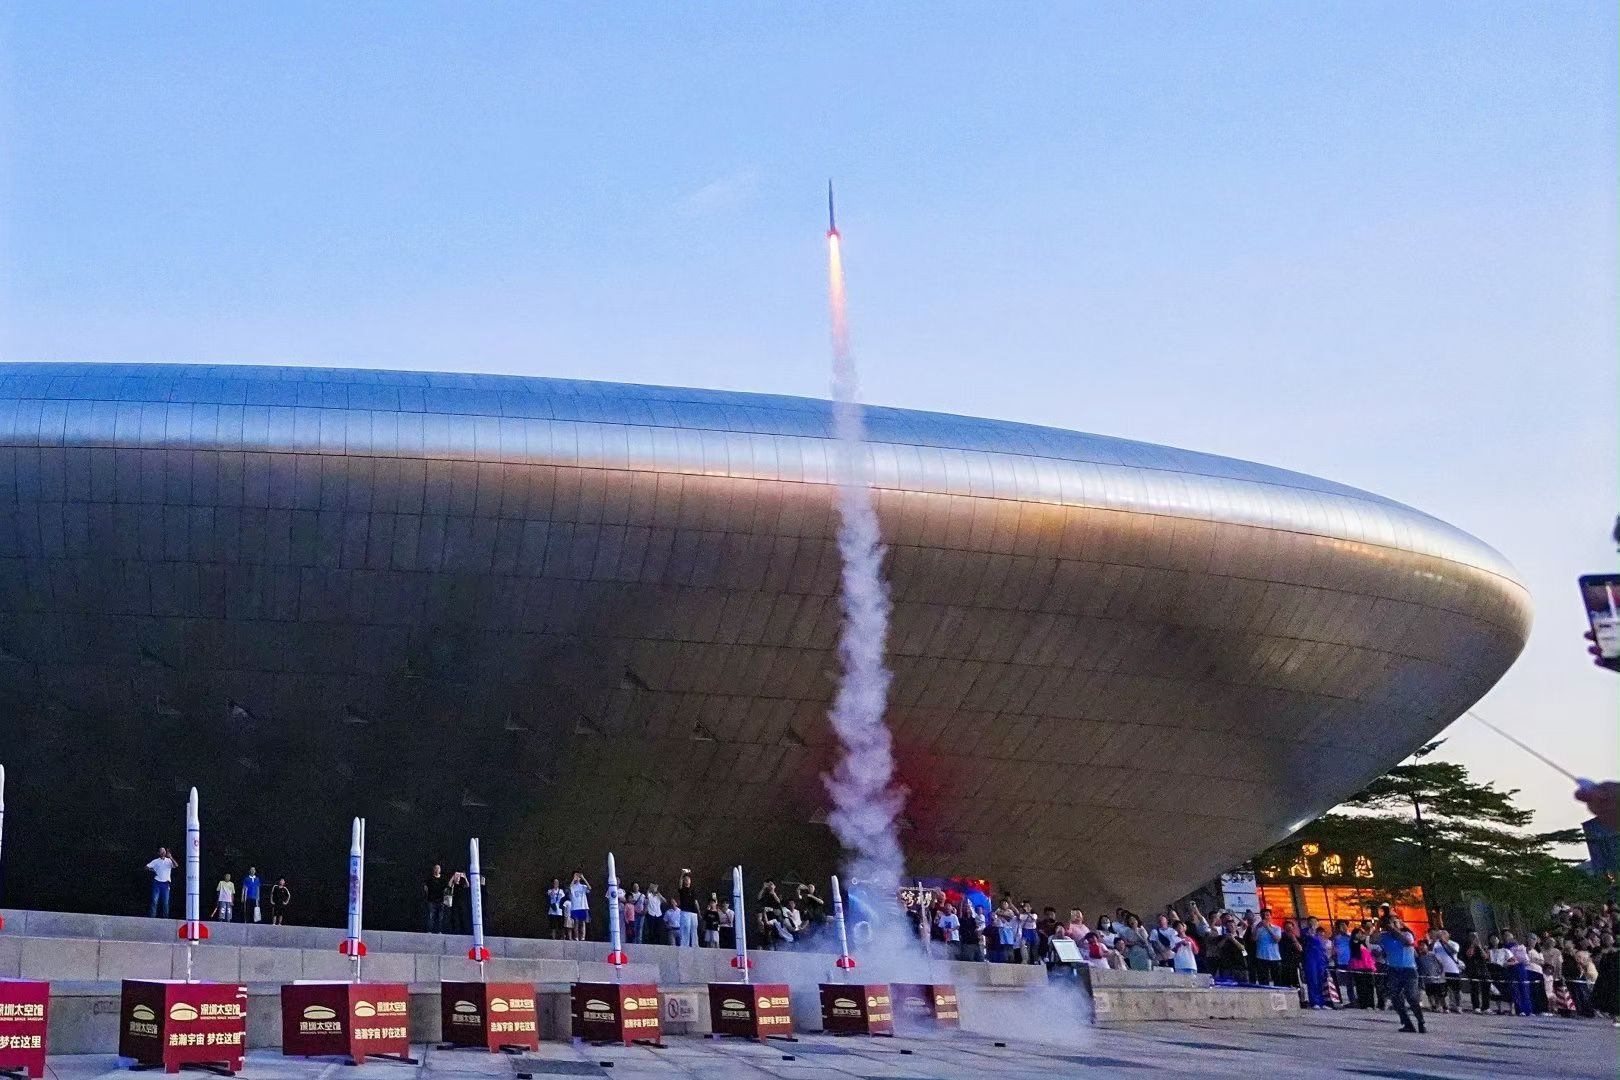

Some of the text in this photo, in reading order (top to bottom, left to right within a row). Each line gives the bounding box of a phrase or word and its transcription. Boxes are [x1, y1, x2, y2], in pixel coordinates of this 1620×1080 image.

[200, 1004, 240, 1016] 深圳太空馆
[0, 1035, 42, 1049] 梦在这里
[169, 1033, 204, 1046] 浩瀚宇宙
[207, 1032, 241, 1046] 梦在这里
